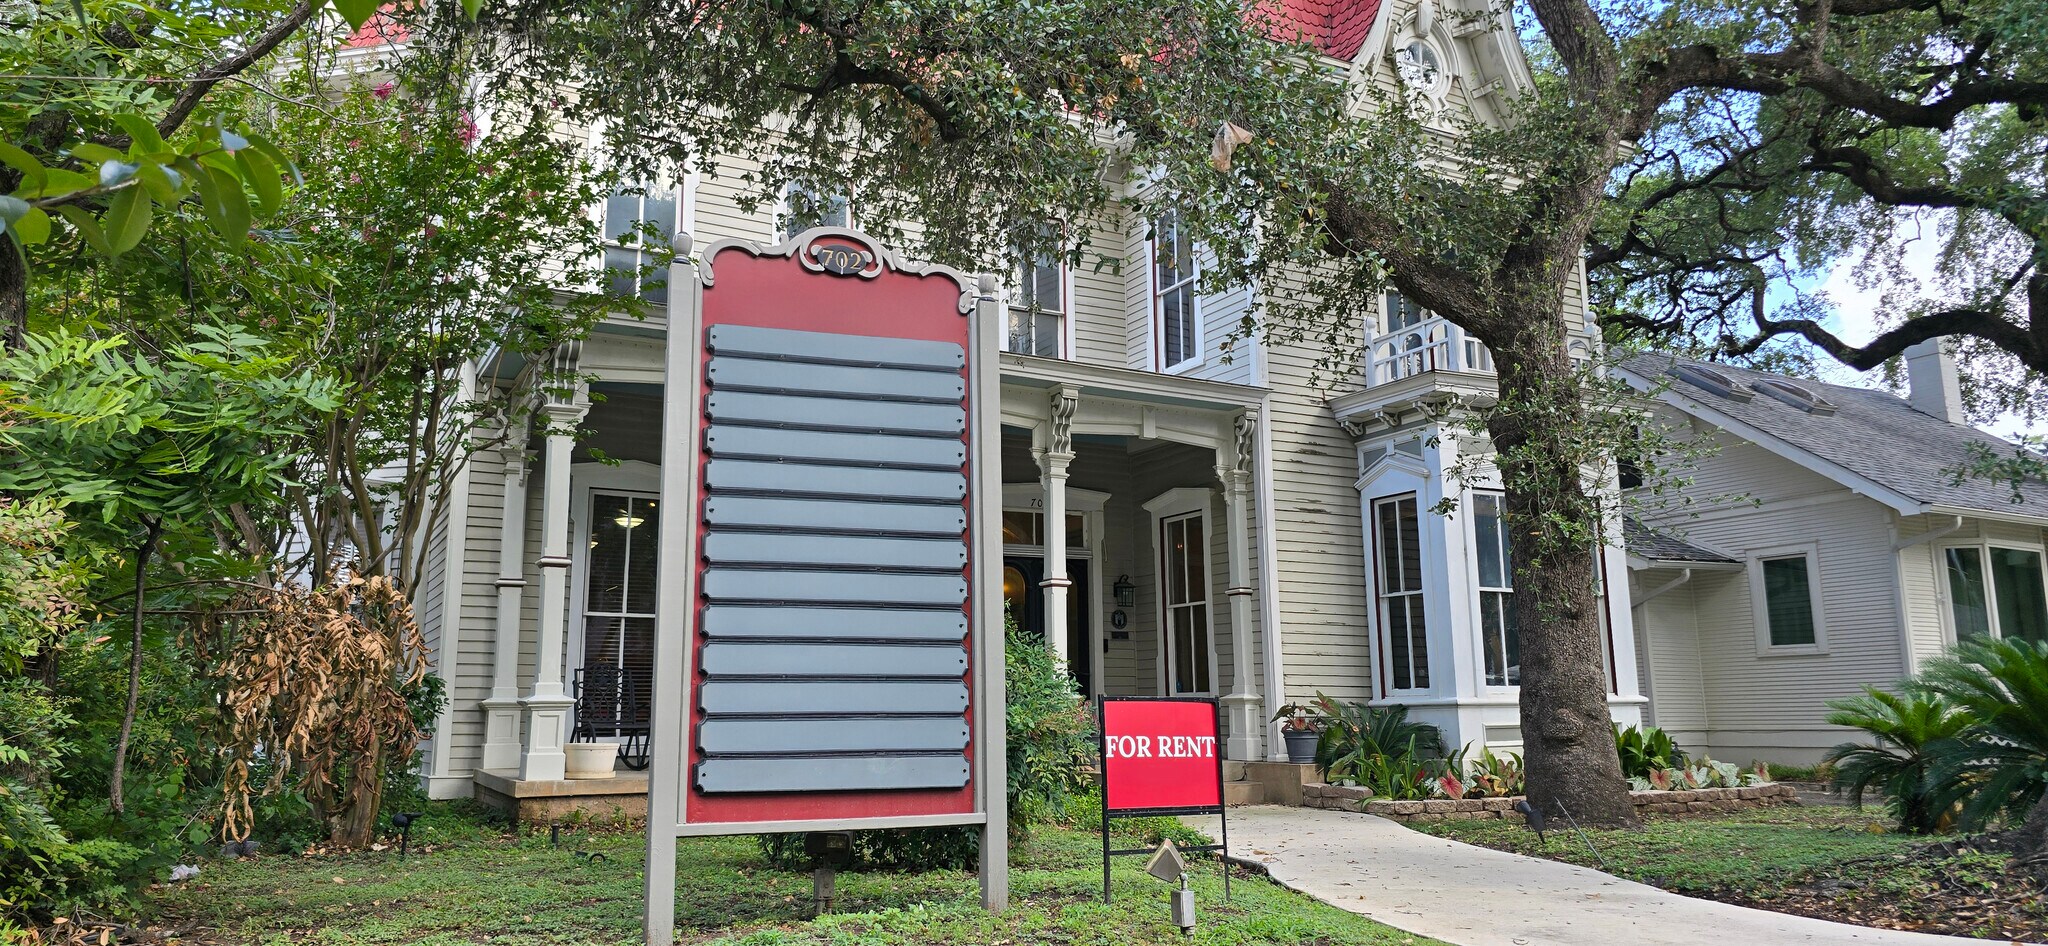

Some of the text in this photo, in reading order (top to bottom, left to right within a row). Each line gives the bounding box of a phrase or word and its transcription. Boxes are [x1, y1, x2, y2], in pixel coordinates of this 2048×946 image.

[822, 249, 861, 269] 702
[1105, 735, 1216, 758] FOR RENT
